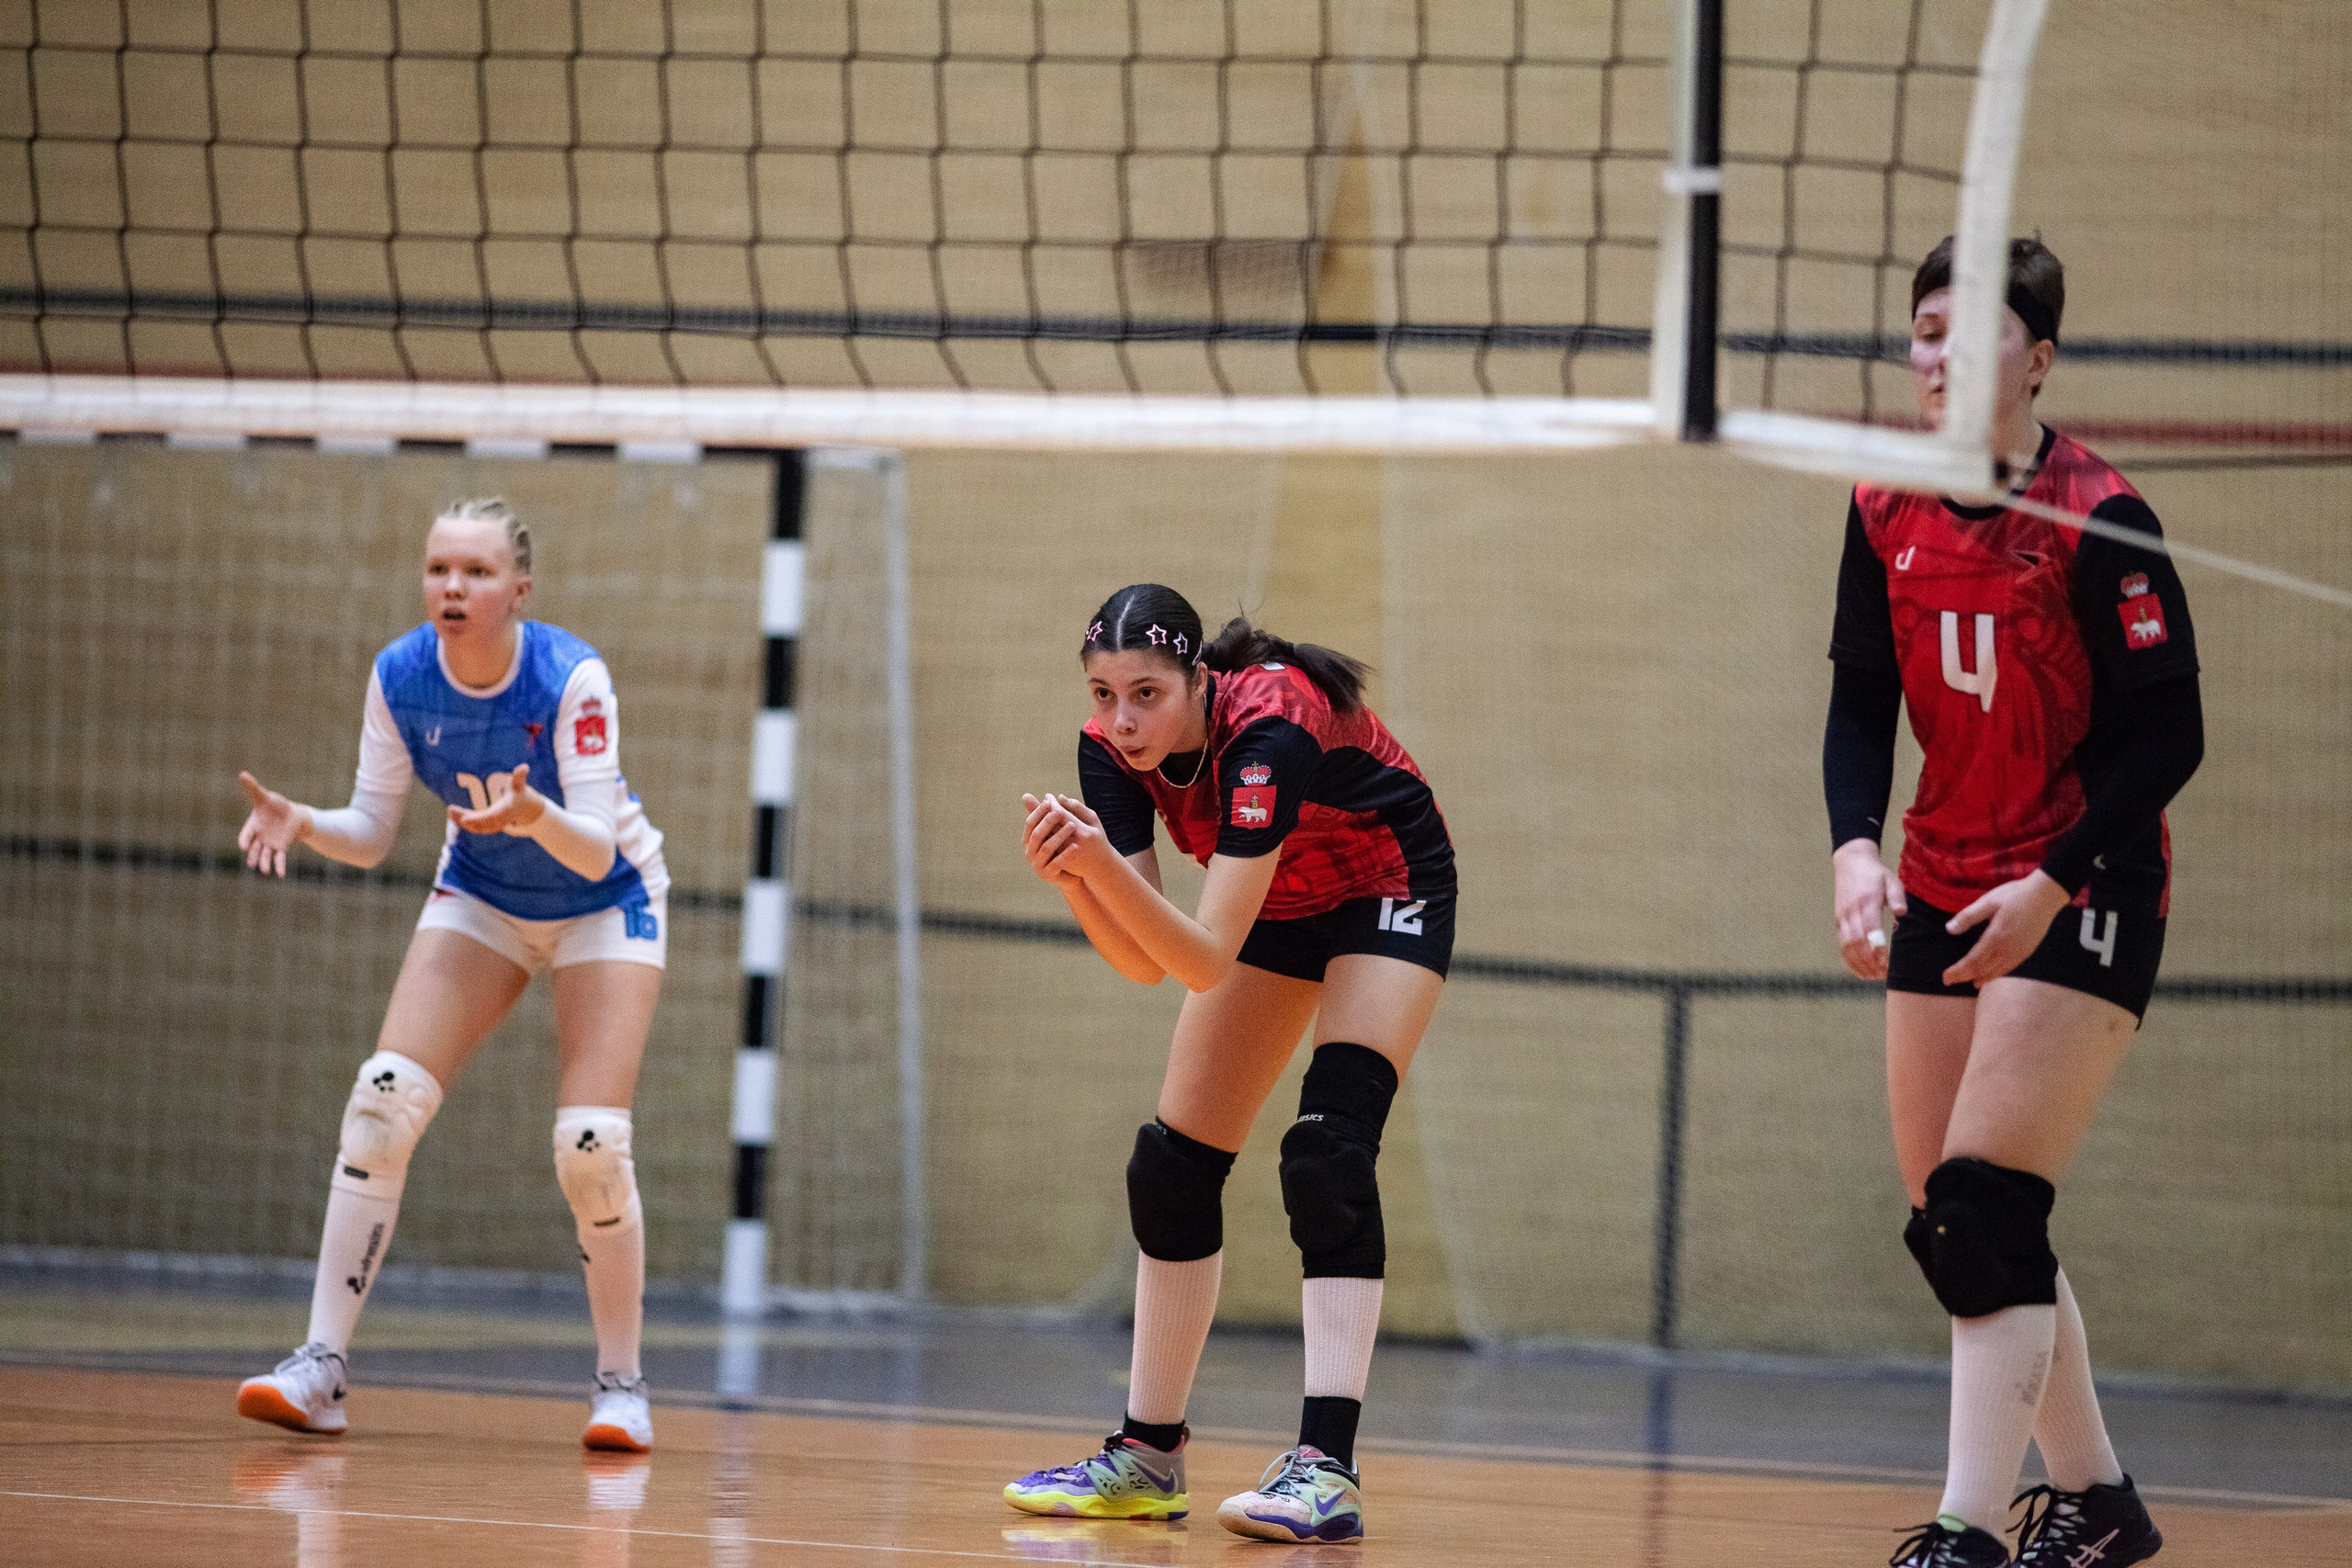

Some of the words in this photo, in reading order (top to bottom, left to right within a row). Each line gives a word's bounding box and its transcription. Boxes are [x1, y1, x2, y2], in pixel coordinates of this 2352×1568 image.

[1940, 610, 1997, 713] 4
[1378, 897, 1427, 936] 12
[2079, 908, 2118, 967] 4
